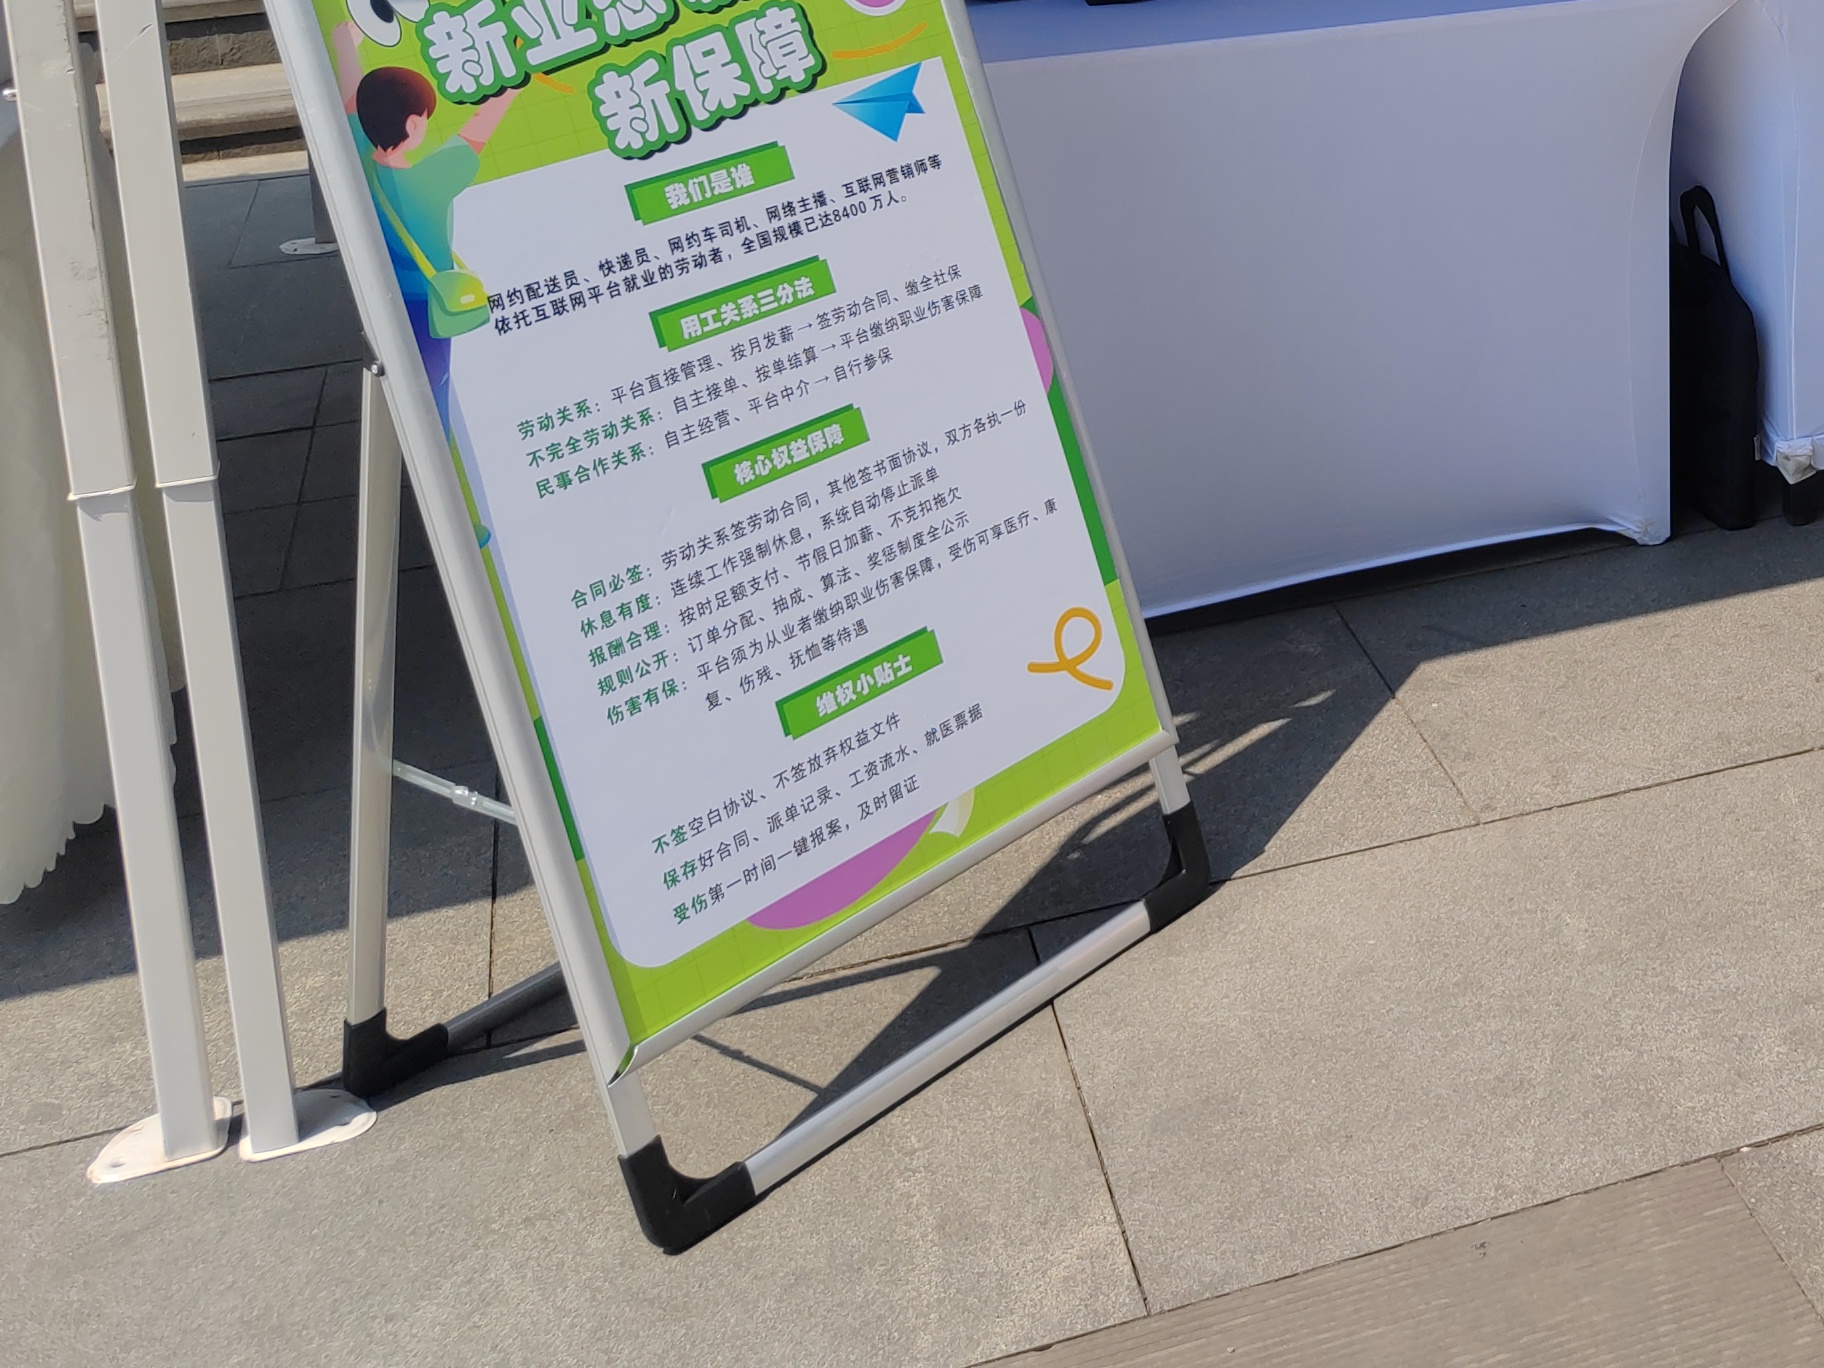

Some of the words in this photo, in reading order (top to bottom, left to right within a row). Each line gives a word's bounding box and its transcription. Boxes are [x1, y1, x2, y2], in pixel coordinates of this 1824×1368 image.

[586, 0, 823, 158] 新保障
[484, 151, 945, 316] 网约配送员、快递员、网约车司机、网络主播、互联网营销师等
[660, 158, 757, 213] 我们是谁
[677, 273, 817, 342] 用工关系三分法
[731, 421, 846, 487] 核心权益保障
[702, 616, 870, 713] 复、伤残、抚恤等待遇
[813, 649, 915, 719] 维权小贴士
[649, 708, 903, 860] 不签空白协议、不签放弃权益文件
[659, 700, 985, 893] 保存好合同、派单记录、工资流水、就医票据
[670, 771, 921, 928] 受伤第一时间一键报案，及时留证
